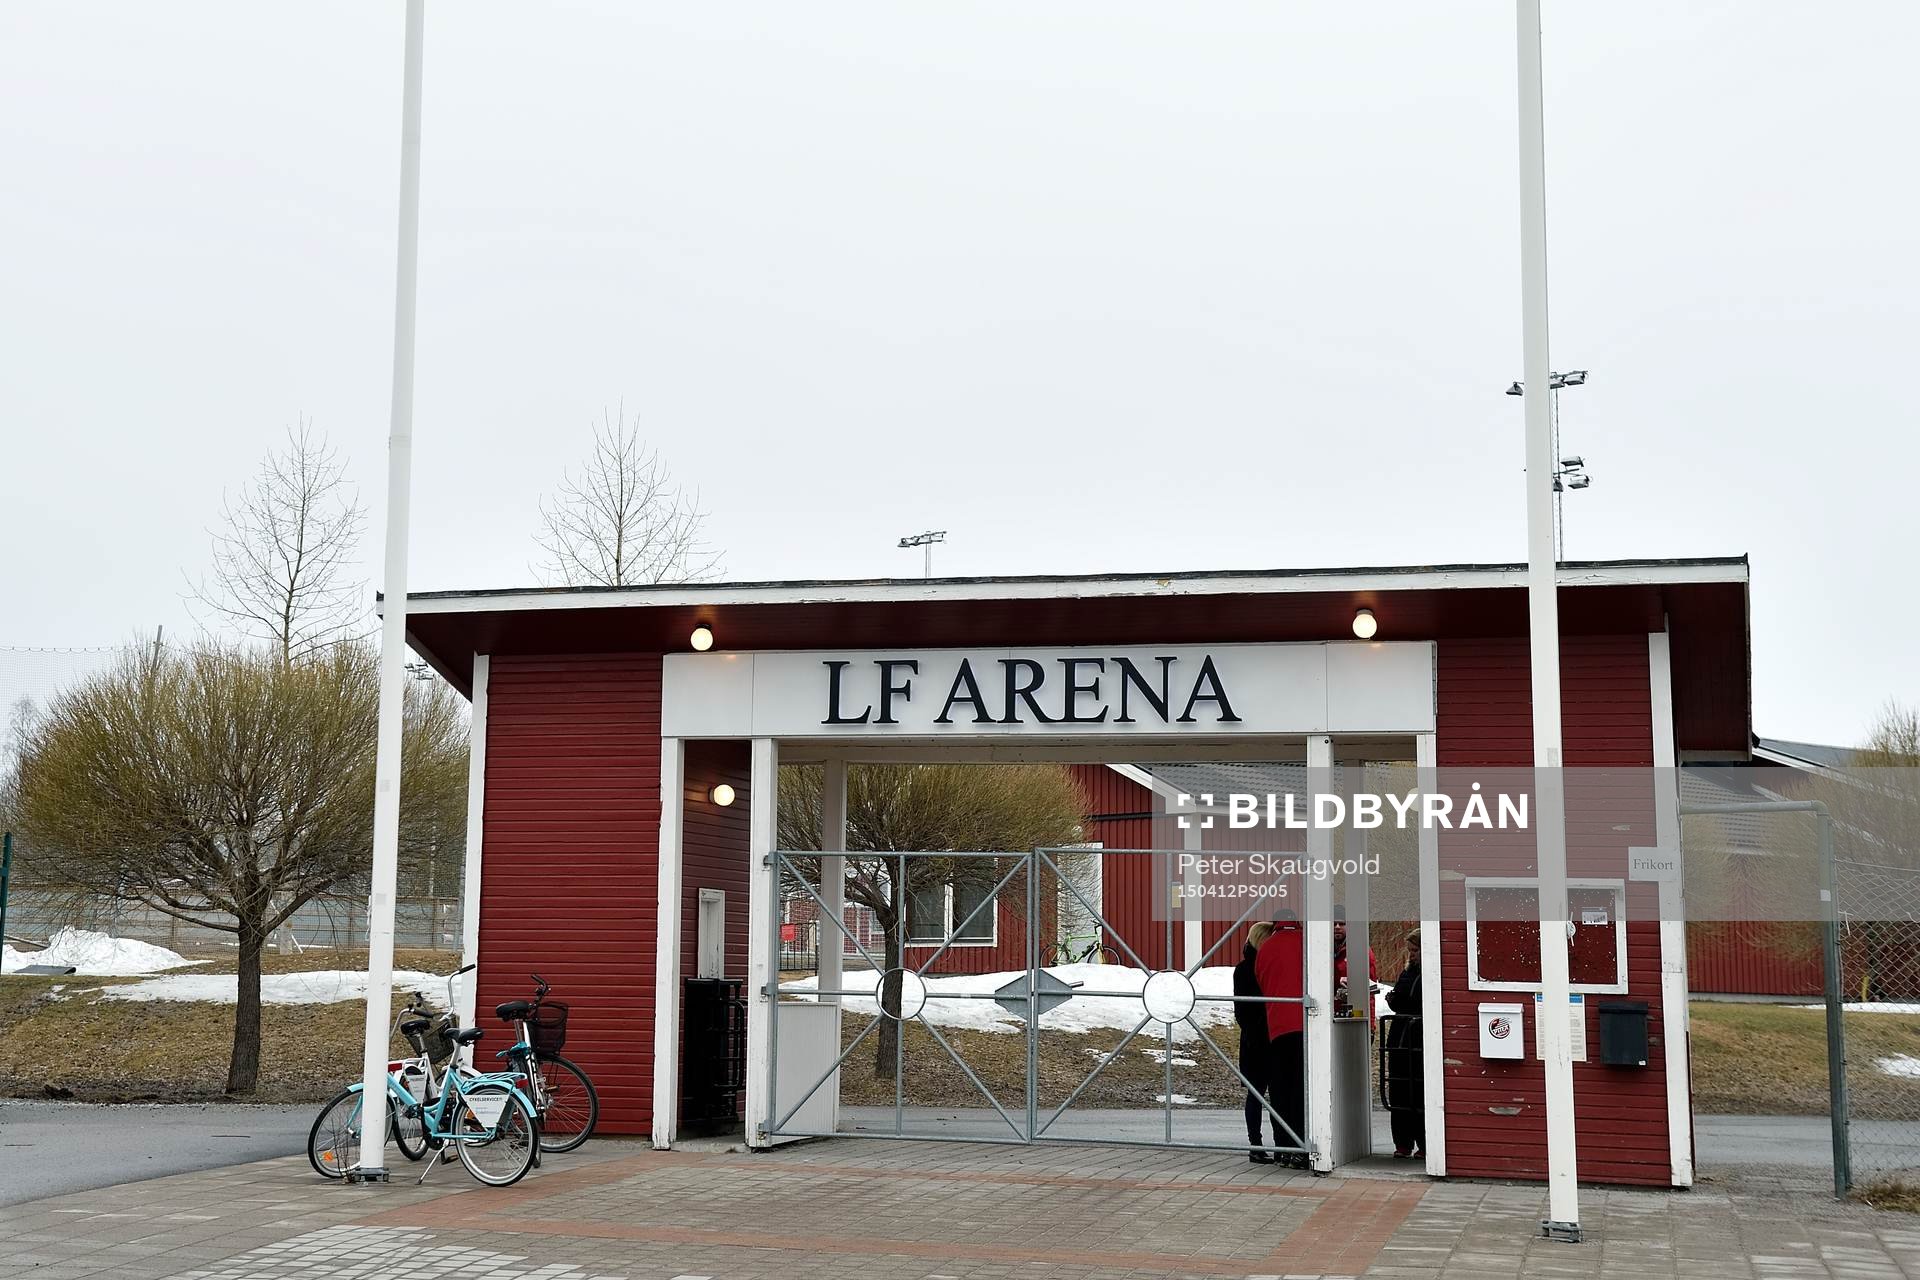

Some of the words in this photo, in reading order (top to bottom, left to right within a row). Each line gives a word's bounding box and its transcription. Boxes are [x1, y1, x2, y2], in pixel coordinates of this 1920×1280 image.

[821, 659, 919, 724] LF
[932, 654, 1243, 724] ARENA
[1633, 858, 1674, 870] Frikort
